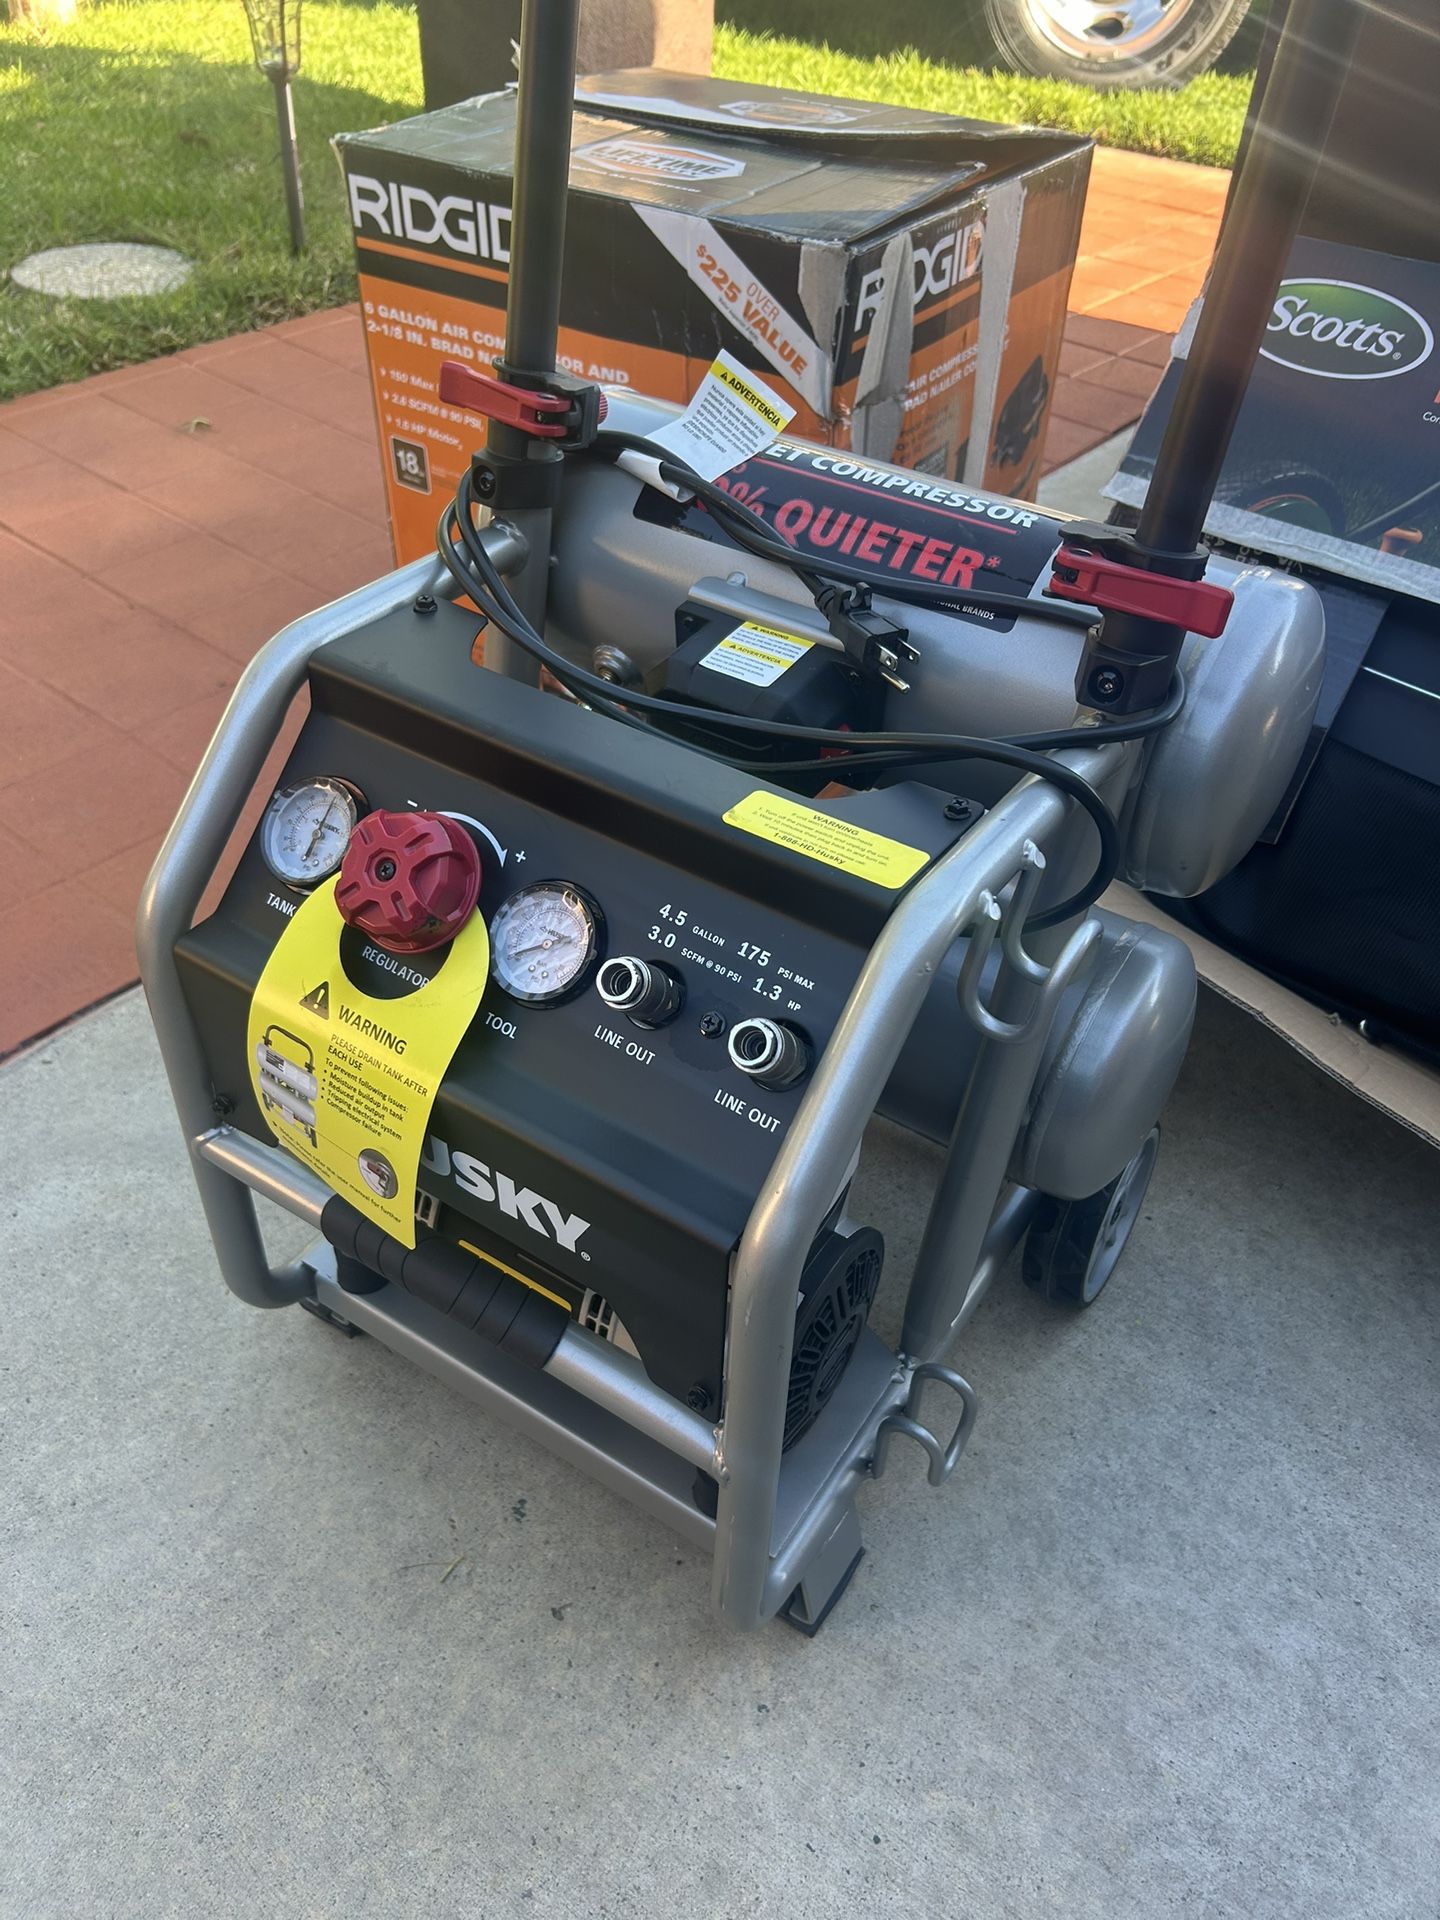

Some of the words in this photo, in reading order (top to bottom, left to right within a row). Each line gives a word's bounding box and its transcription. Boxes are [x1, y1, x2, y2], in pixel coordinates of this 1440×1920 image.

[854, 220, 983, 333] RDGID
[696, 244, 742, 303] $225
[742, 299, 808, 377] VALUE
[746, 282, 781, 322] OVER
[1266, 295, 1406, 358] Scotts
[377, 305, 438, 331] GALLON
[442, 323, 469, 341] AIR
[588, 364, 630, 384] AND
[430, 336, 474, 359] BRAD
[729, 377, 781, 427] ADVERTENCIA
[811, 455, 1040, 529] COMPRESSOR
[962, 605, 996, 621] BRANDS
[737, 646, 782, 665] ADVERTENCIA
[773, 831, 847, 866] 1-888-HD-Husky
[811, 815, 860, 836] WARNING
[265, 892, 297, 918] TANK
[647, 925, 677, 948] 3.0
[681, 947, 706, 965] SCFM
[705, 959, 714, 969] @
[714, 964, 726, 975] 90
[726, 971, 743, 983] PSI
[752, 977, 783, 1001] 1.3
[787, 999, 802, 1012] HP
[658, 903, 688, 926] 4.5
[692, 925, 726, 947] GALLON
[737, 941, 772, 967] 175
[777, 966, 794, 980] PSI
[794, 974, 816, 991] MAX
[338, 1005, 408, 1056] WARNING
[485, 1011, 519, 1040] TOOL
[593, 1024, 624, 1050] LINE
[626, 1041, 656, 1066] OUT
[327, 1045, 348, 1063] EACH
[349, 1058, 364, 1072] USE
[330, 1034, 358, 1055] PLEASE
[357, 1050, 382, 1070] DRAIN
[383, 1063, 406, 1083] TANK
[403, 1077, 428, 1097] AFTER
[325, 1058, 334, 1068] To
[333, 1063, 358, 1084] prevent
[358, 1076, 388, 1101] following
[388, 1095, 409, 1113] issues:
[328, 1081, 355, 1102] Reduced
[355, 1097, 364, 1107] air
[364, 1102, 386, 1121] output
[330, 1071, 358, 1093] Moisture
[357, 1088, 382, 1109] buildup
[382, 1102, 390, 1112] in
[390, 1106, 405, 1122] tank
[326, 1098, 362, 1124] Compressor
[362, 1120, 383, 1138] failure
[327, 1089, 352, 1111] Tripping
[352, 1104, 380, 1127] electrical
[380, 1121, 403, 1141] system
[714, 1088, 745, 1116] LINE
[748, 1107, 782, 1134] OUT
[420, 1134, 592, 1253] USKY
